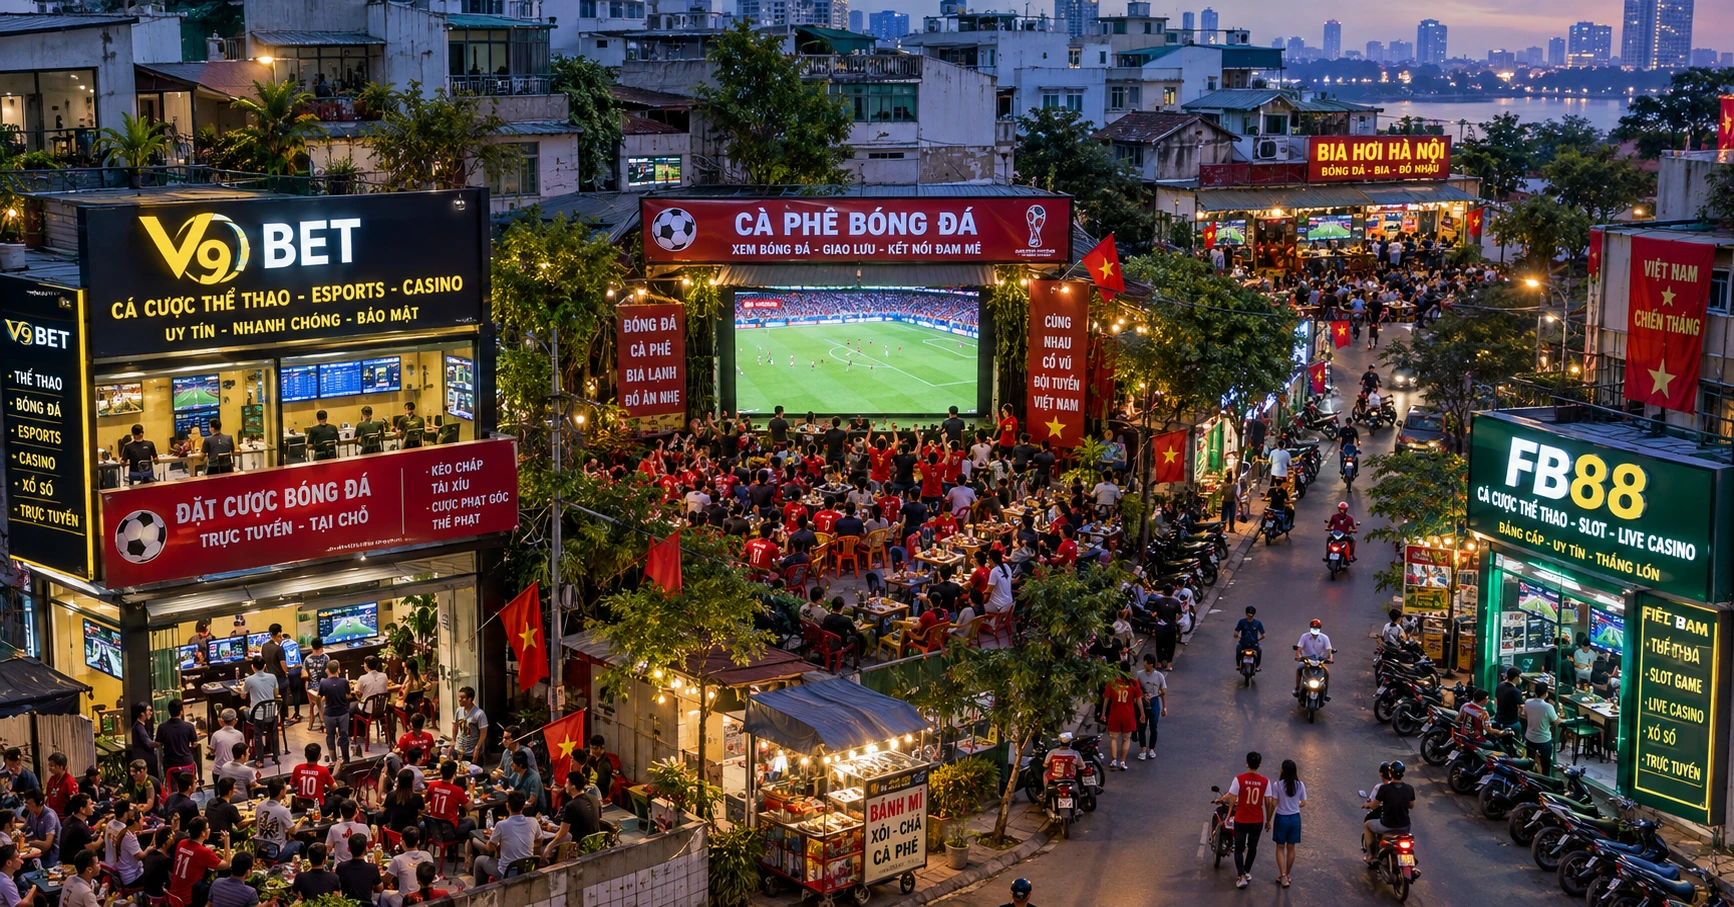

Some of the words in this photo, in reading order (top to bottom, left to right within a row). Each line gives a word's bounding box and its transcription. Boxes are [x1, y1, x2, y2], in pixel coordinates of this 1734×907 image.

[1352, 140, 1383, 161] HƠI
[1388, 138, 1412, 160] HÀ
[1416, 137, 1445, 163] NỘI
[1374, 165, 1390, 174] BIA
[735, 207, 773, 236] CÀ
[783, 207, 838, 236] PHÊ
[849, 206, 928, 236] BÓNG
[937, 206, 978, 235] ĐÁ
[263, 218, 361, 269] BET
[731, 244, 756, 255] XEM
[759, 241, 791, 255] BÓNG
[794, 241, 811, 255] ĐÁ
[822, 243, 850, 255] GIAO
[853, 242, 876, 255] LƯU
[888, 241, 909, 255] KẾT
[935, 244, 961, 255] ĐAM
[1644, 257, 1669, 282] VIỆT
[1671, 263, 1698, 283] NAM
[111, 297, 138, 320] CÁ
[144, 295, 195, 318] CƯỢC
[201, 287, 236, 312] THỂ
[241, 289, 291, 309] THAO
[311, 281, 385, 303] ESPORTS
[402, 274, 463, 296] CASINO
[165, 326, 186, 342] UY
[190, 322, 215, 339] TÍN
[233, 318, 286, 336] NHANH
[290, 312, 341, 330] CHÓNG
[390, 304, 419, 324] MẬT
[660, 314, 677, 331] ĐÁ
[1634, 308, 1664, 331] CHIẾN
[630, 340, 646, 357] CÀ
[1043, 335, 1072, 349] NHAU
[35, 374, 63, 390] THAO
[648, 366, 677, 383] LẠNH
[16, 396, 44, 415] BÓNG
[47, 401, 62, 418] ĐÁ
[659, 390, 680, 406] NHẸ
[1033, 394, 1054, 411] VIỆT
[1056, 397, 1079, 412] NAM
[18, 424, 62, 445] ESPORTS
[19, 451, 56, 470] CASINO
[451, 477, 470, 492] XÍU
[1504, 436, 1648, 521] FB88
[175, 495, 217, 527] ĐẶT
[223, 489, 278, 518] CƯỢC
[284, 480, 338, 509] BÓNG
[344, 471, 372, 500] ĐÁ
[461, 494, 486, 509] PHẠT
[489, 490, 509, 504] GÓC
[20, 504, 45, 523] TRỰC
[454, 513, 481, 527] PHẠT
[1477, 485, 1490, 503] CÁ
[1491, 490, 1517, 514] CƯỢC
[1540, 505, 1568, 528] THAO
[1578, 517, 1607, 539] SLOT
[1618, 526, 1645, 549] LIVE
[1647, 534, 1696, 561] CASINO
[199, 528, 240, 549] TRỰC
[309, 514, 333, 533] TẠI
[1553, 539, 1567, 554] UY
[1568, 543, 1586, 560] TÍN
[1649, 667, 1673, 686] SLOT
[1674, 673, 1703, 694] GAME
[1648, 697, 1668, 714] LIVE
[1669, 702, 1704, 724] CASINO
[1645, 753, 1669, 773] TRỰC
[301, 775, 317, 796] 10
[1245, 786, 1260, 805] 10
[434, 793, 447, 814] 11
[869, 797, 904, 822] BÁNH
[175, 853, 190, 879] 11
